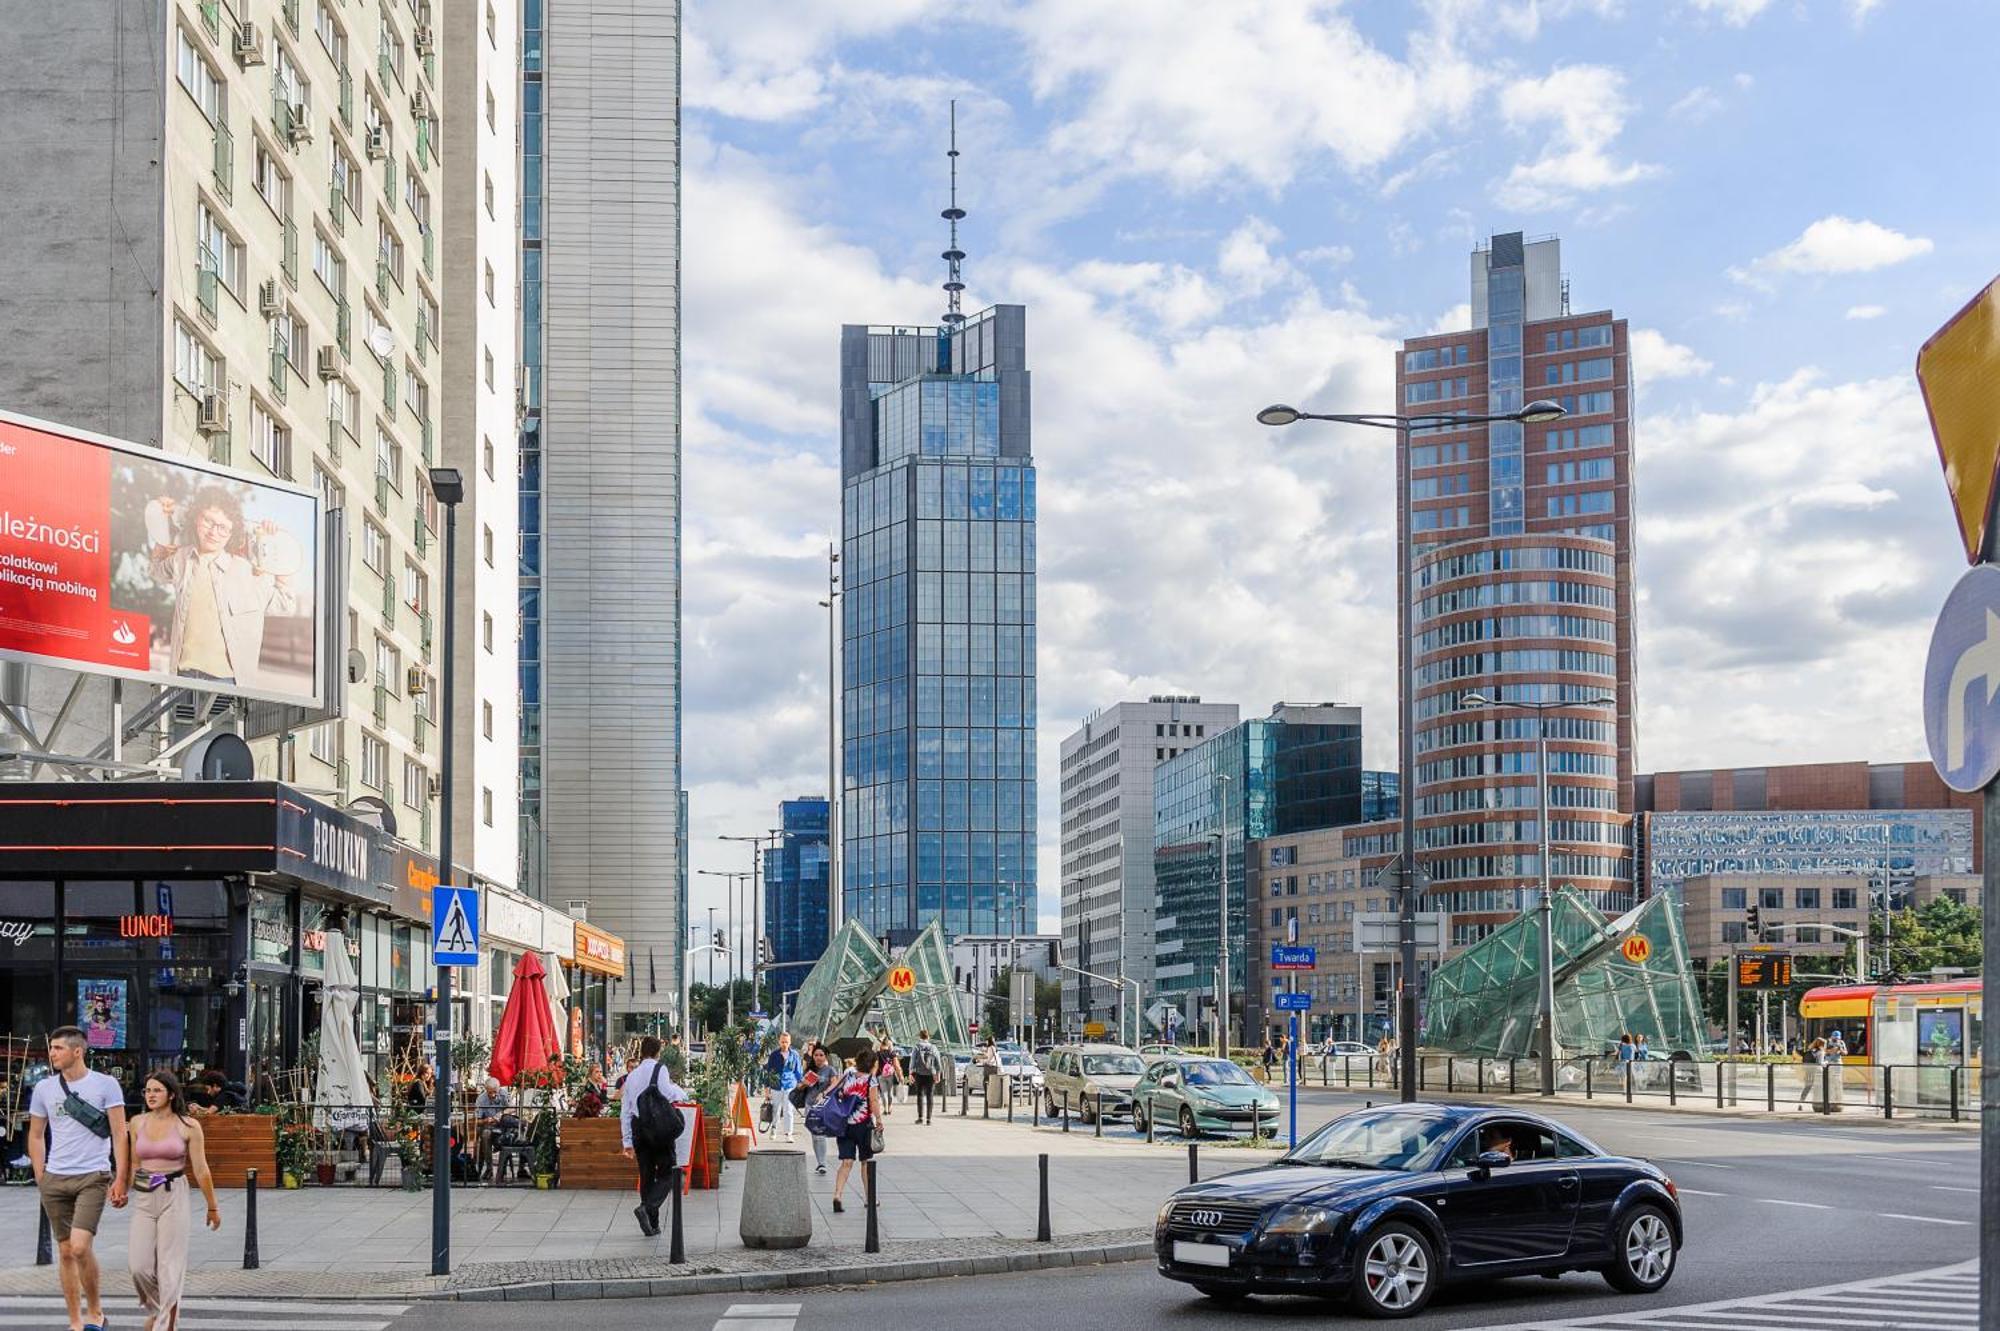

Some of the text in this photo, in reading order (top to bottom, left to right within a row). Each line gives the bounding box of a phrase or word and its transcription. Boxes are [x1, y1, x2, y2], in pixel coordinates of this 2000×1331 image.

[0, 511, 99, 554] leżności
[0, 568, 97, 602] likacją mobilną
[313, 816, 368, 881] BROOKLYN
[120, 915, 168, 937] LUNCH
[1279, 952, 1310, 963] Twarda
